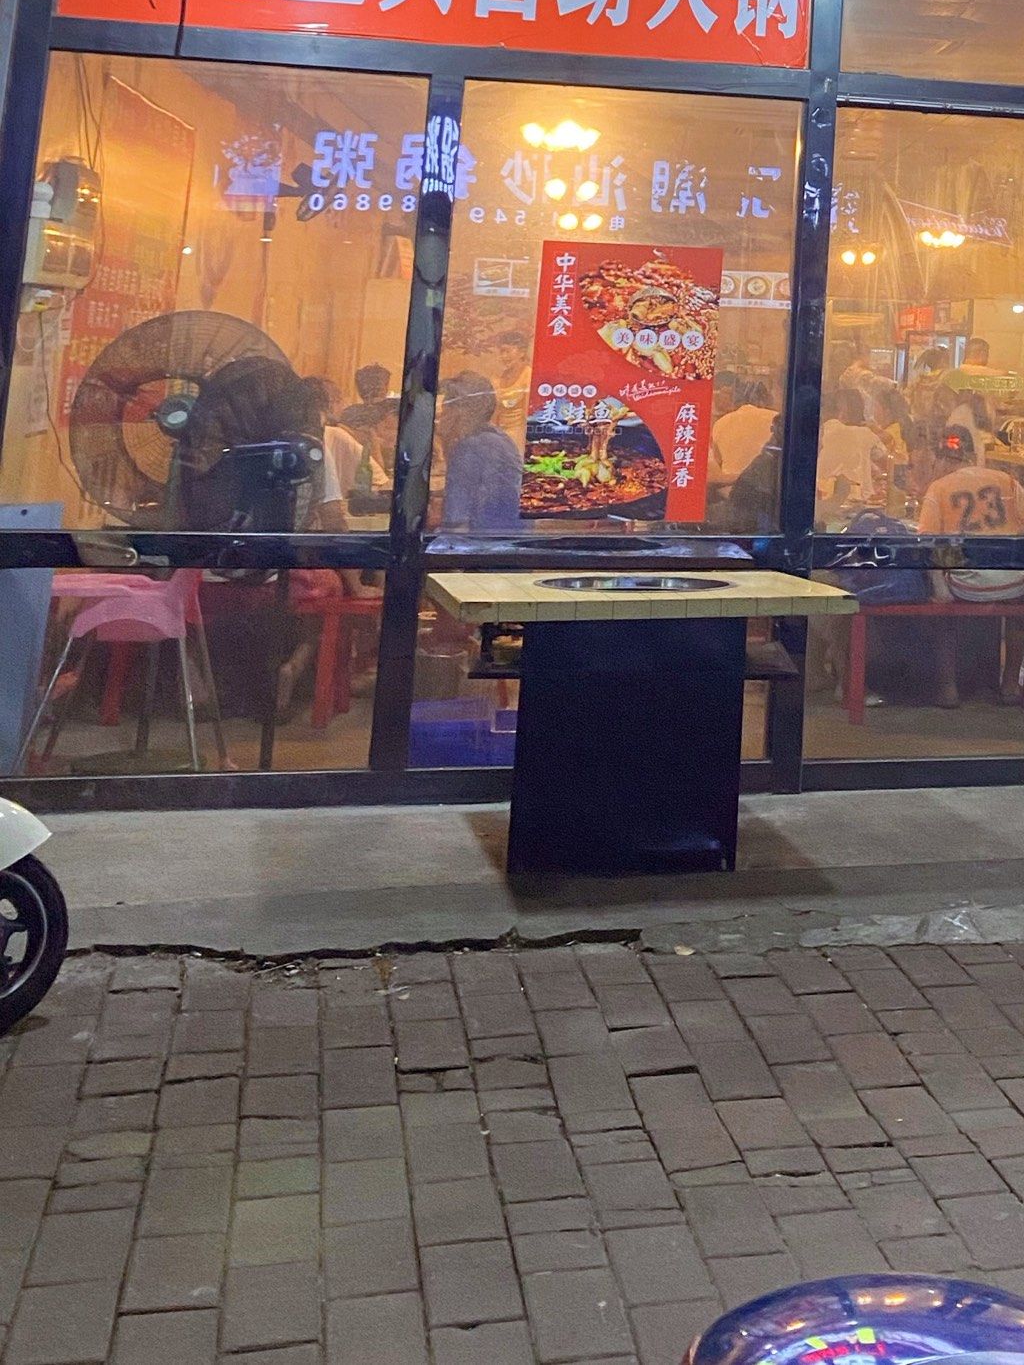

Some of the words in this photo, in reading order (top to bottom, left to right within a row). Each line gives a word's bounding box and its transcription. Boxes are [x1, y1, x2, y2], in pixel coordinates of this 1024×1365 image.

[548, 252, 576, 336] 中华美食
[613, 329, 703, 350] 美味盛宴
[537, 399, 612, 426] 美蛙鱼
[671, 403, 698, 488] 麻辣鲜香
[950, 485, 1006, 531] 23
